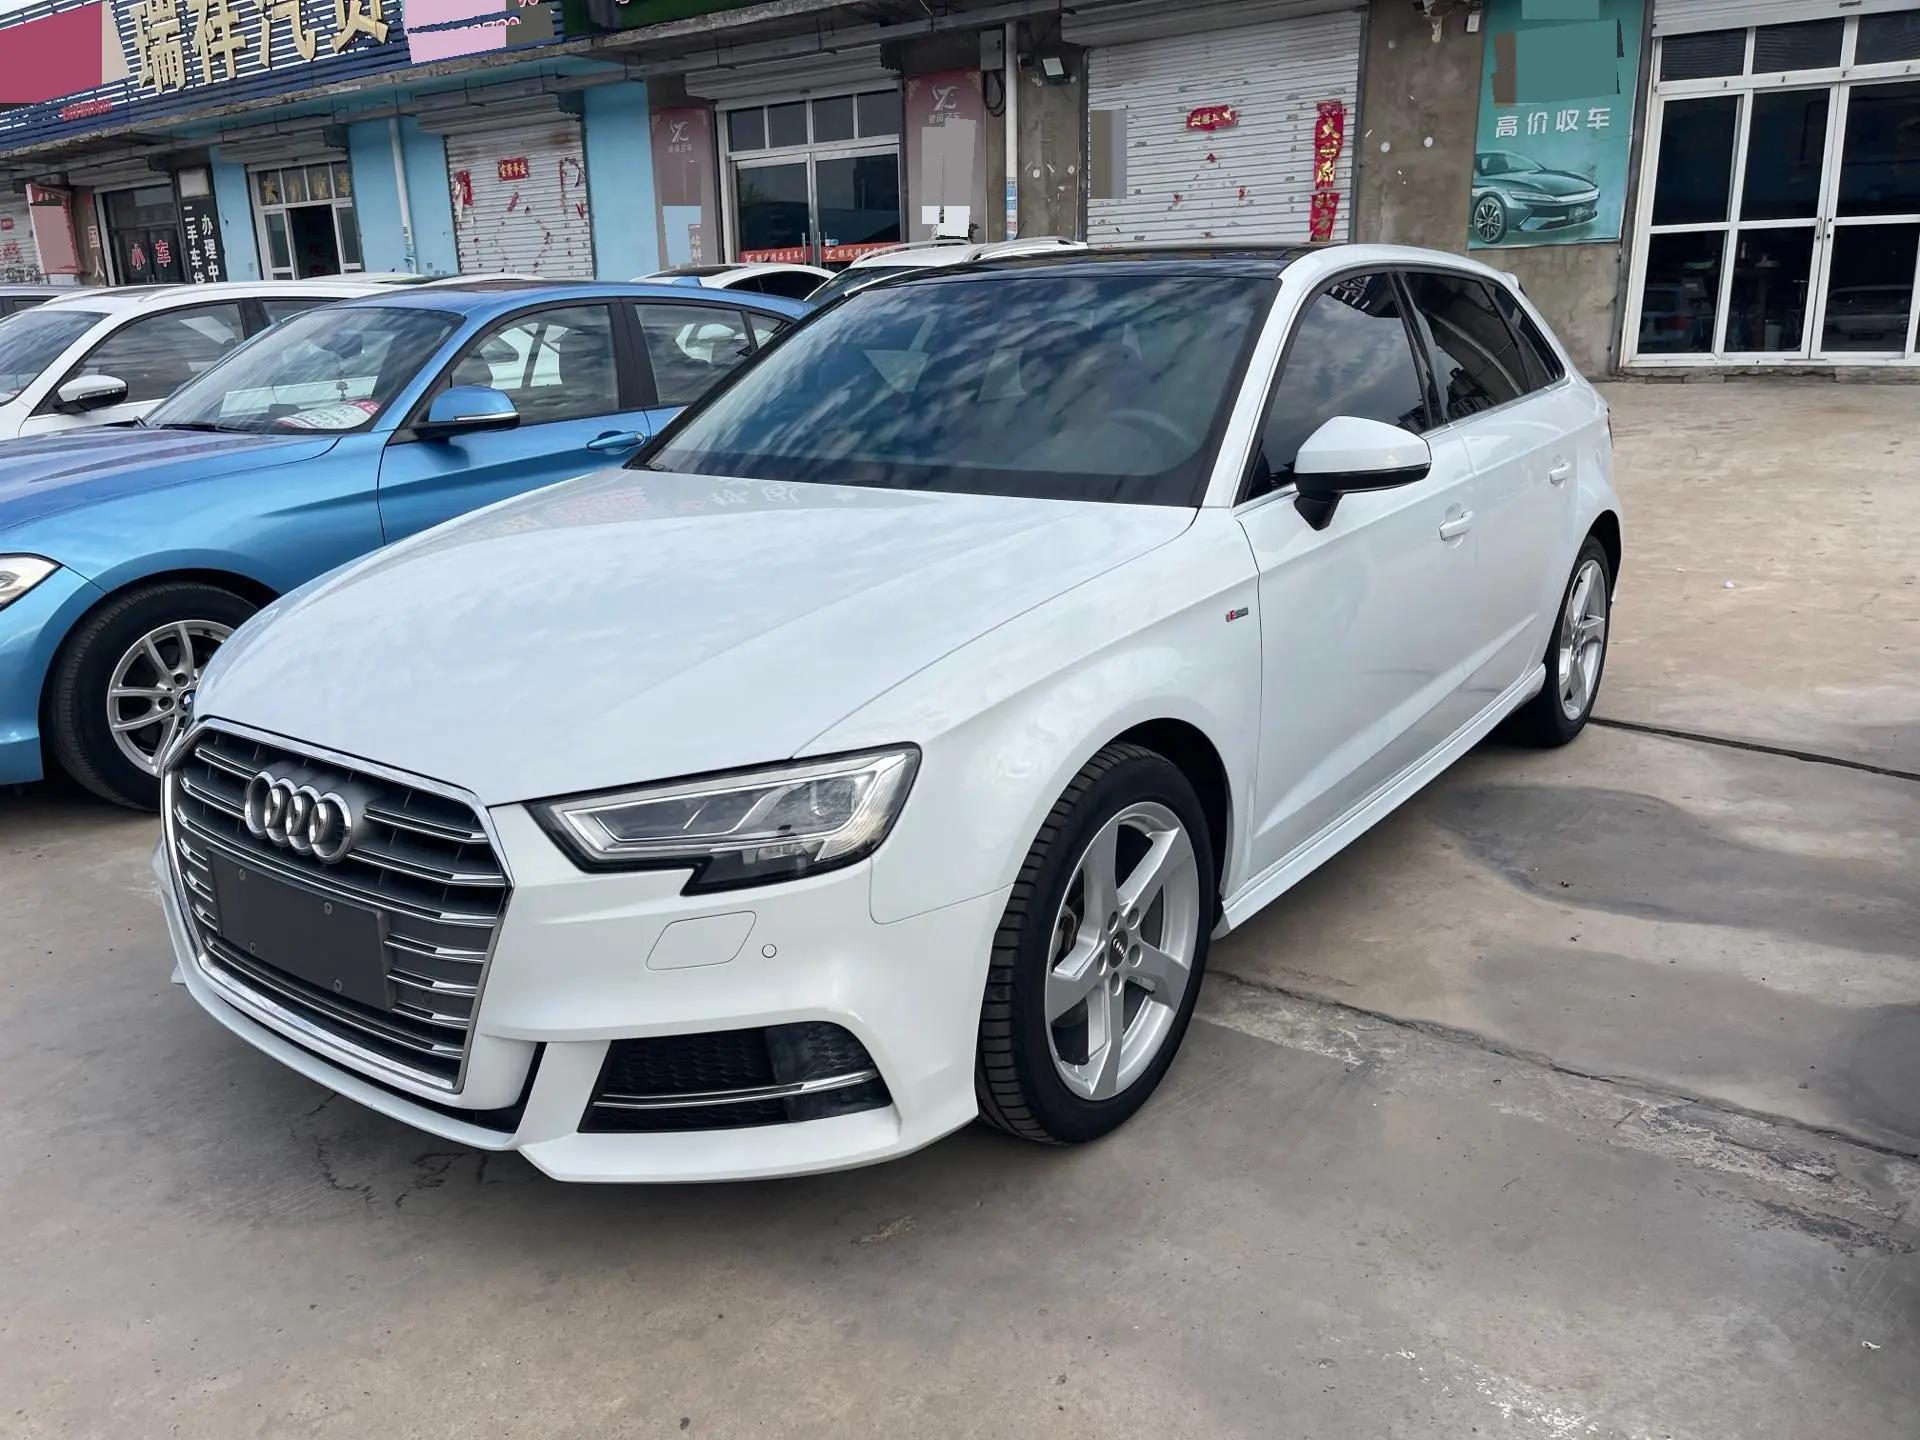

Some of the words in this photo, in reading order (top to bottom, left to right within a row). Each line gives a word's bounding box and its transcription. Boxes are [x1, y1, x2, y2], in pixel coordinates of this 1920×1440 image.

[1495, 107, 1611, 138] 高价收车
[202, 214, 219, 283] 办理中
